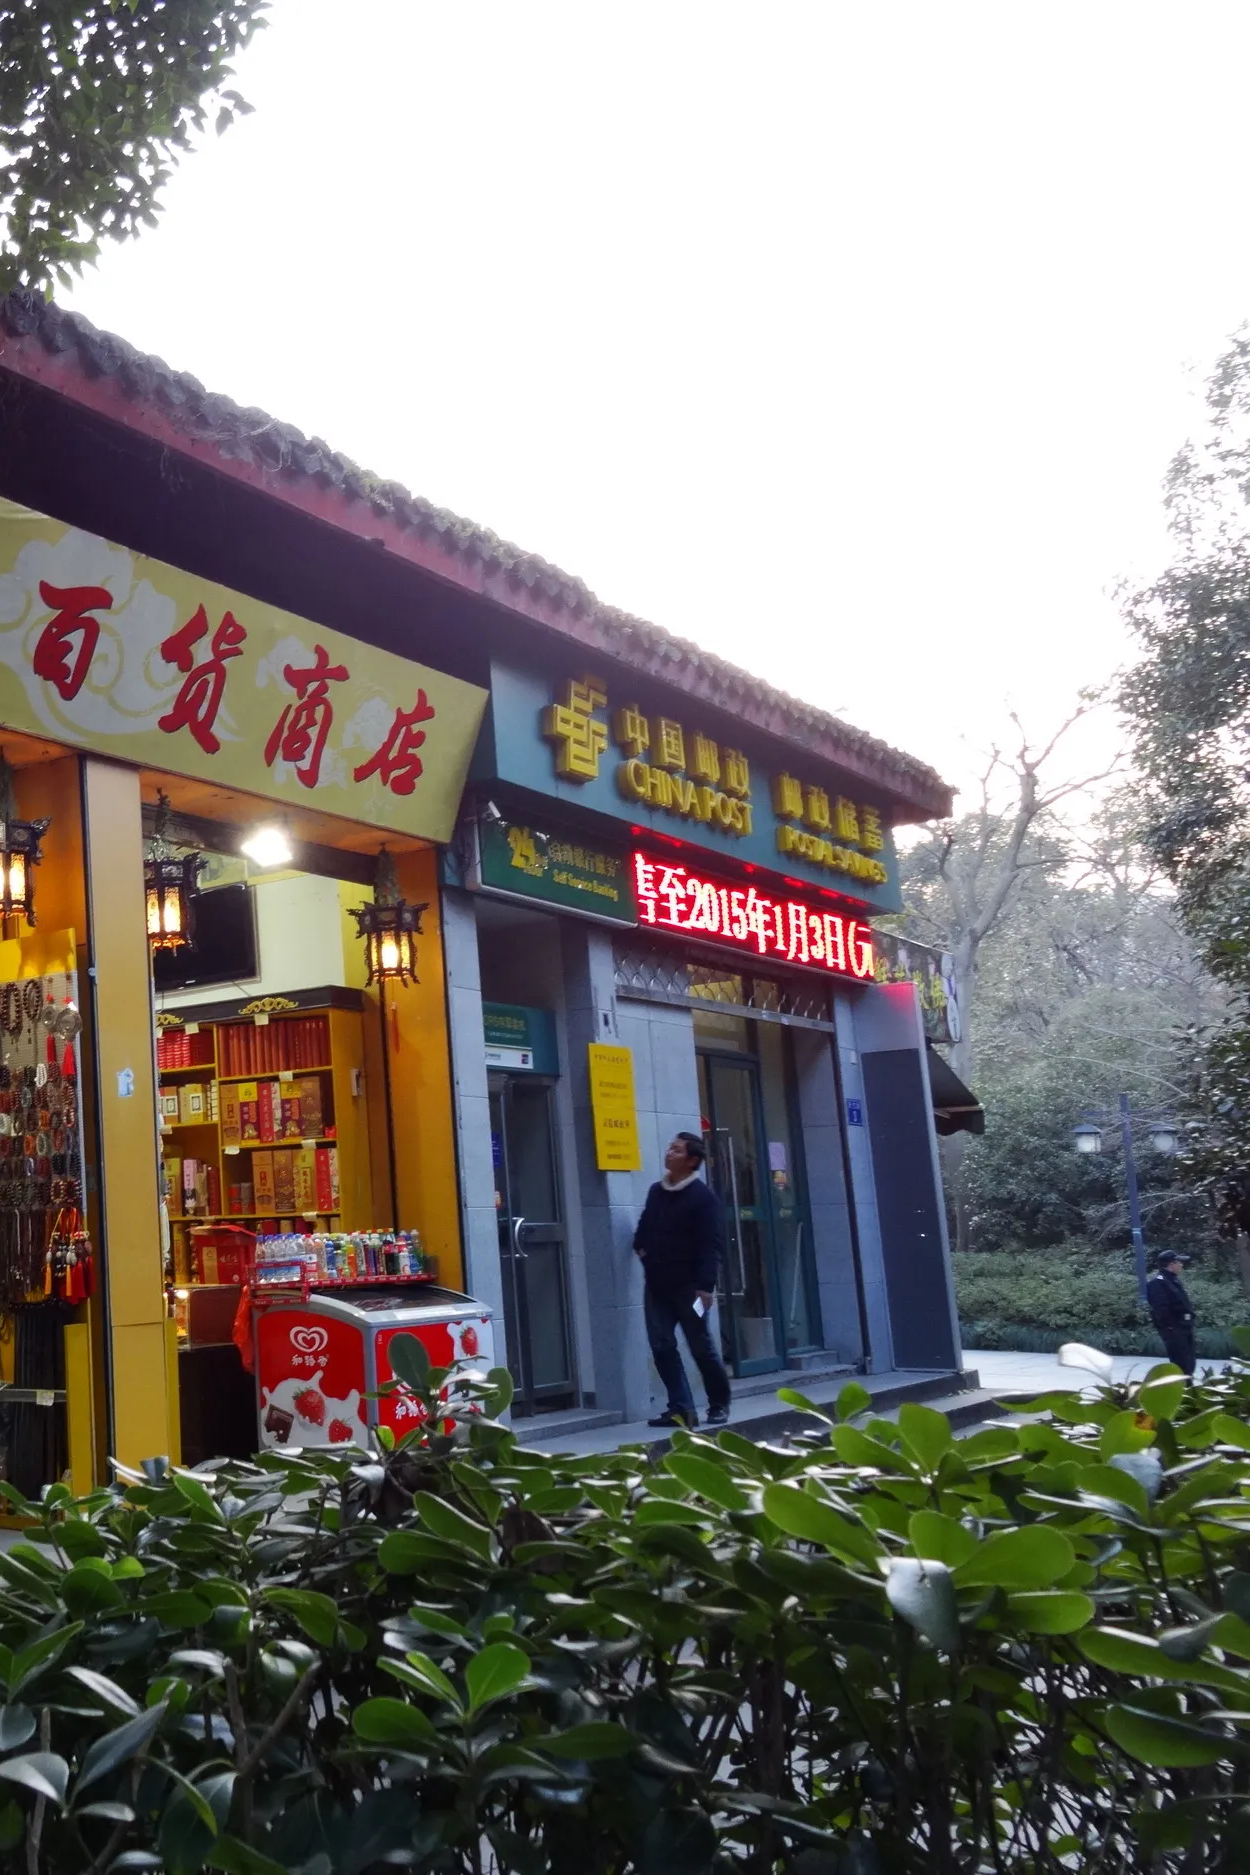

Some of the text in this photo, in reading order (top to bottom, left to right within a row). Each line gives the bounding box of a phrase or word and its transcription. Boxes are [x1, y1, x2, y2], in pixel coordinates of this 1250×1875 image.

[618, 703, 751, 798] 中国邮政
[621, 759, 753, 836] CHINA POST
[777, 770, 884, 851] 邮政储蓄
